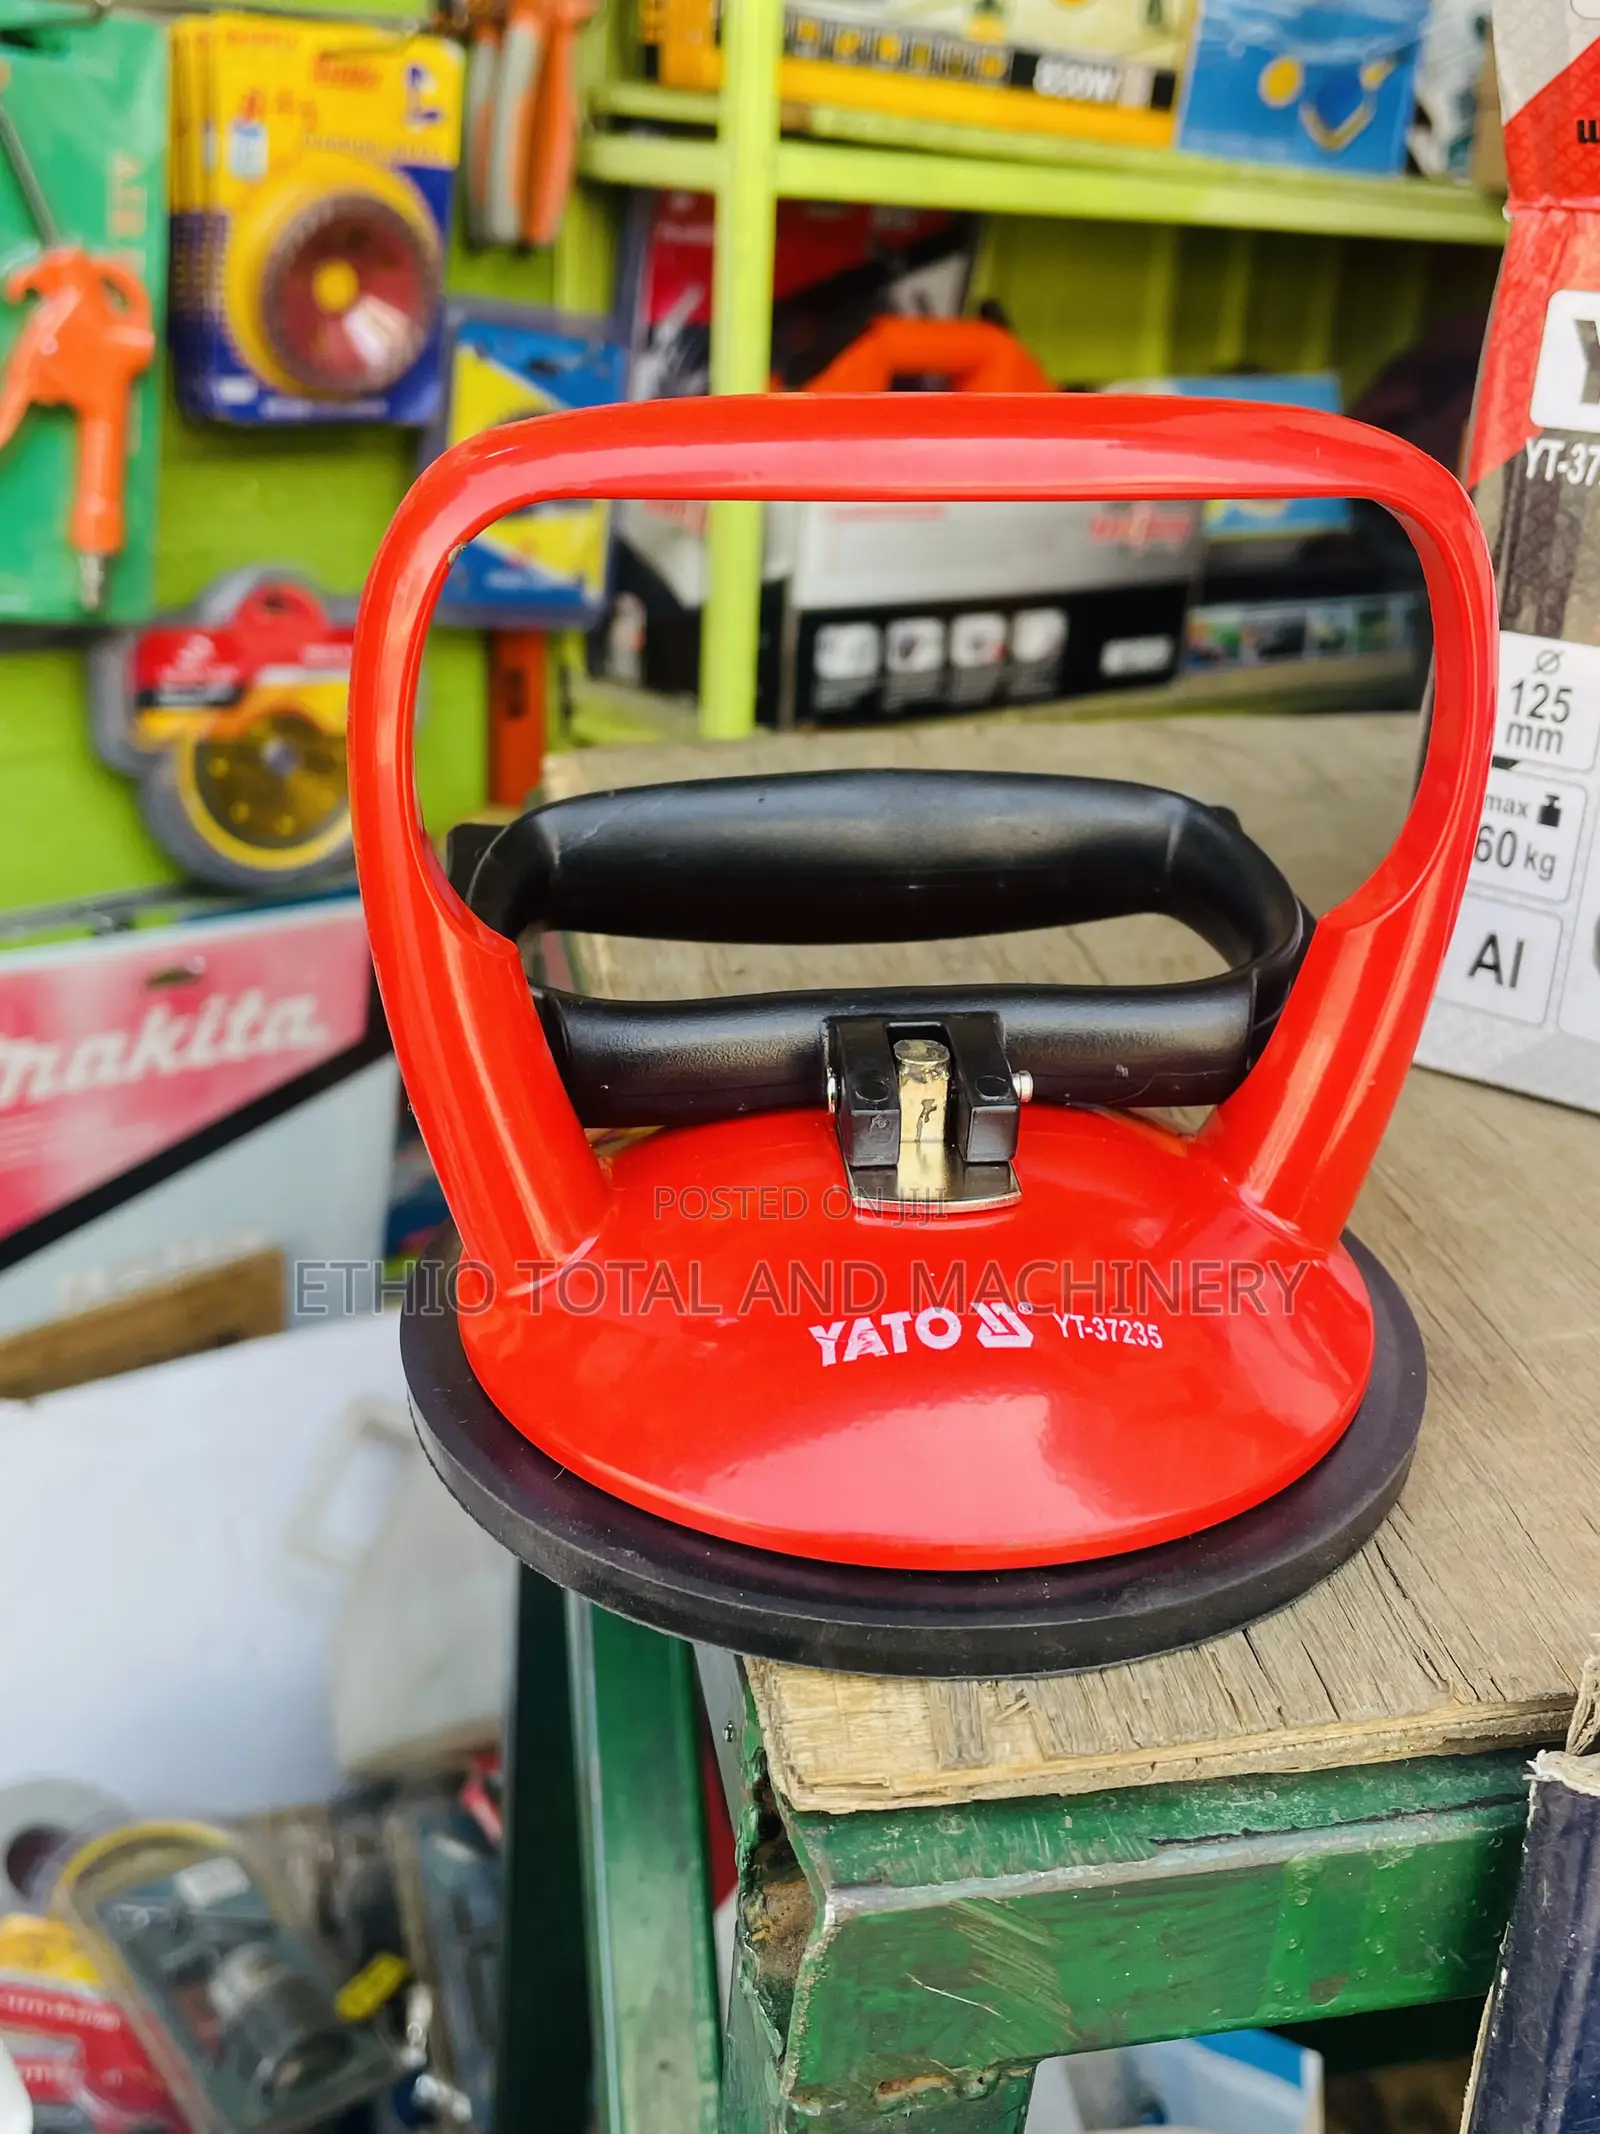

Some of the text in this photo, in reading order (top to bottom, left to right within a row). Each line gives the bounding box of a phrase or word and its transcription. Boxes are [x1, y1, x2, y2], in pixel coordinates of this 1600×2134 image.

[1526, 437, 1600, 486] YT-37
[1511, 679, 1572, 723] 125
[1505, 722, 1564, 754] mm
[1484, 793, 1529, 818] max
[1474, 825, 1556, 881] 60 kg
[808, 1306, 1164, 1367] YATO YT-37235
